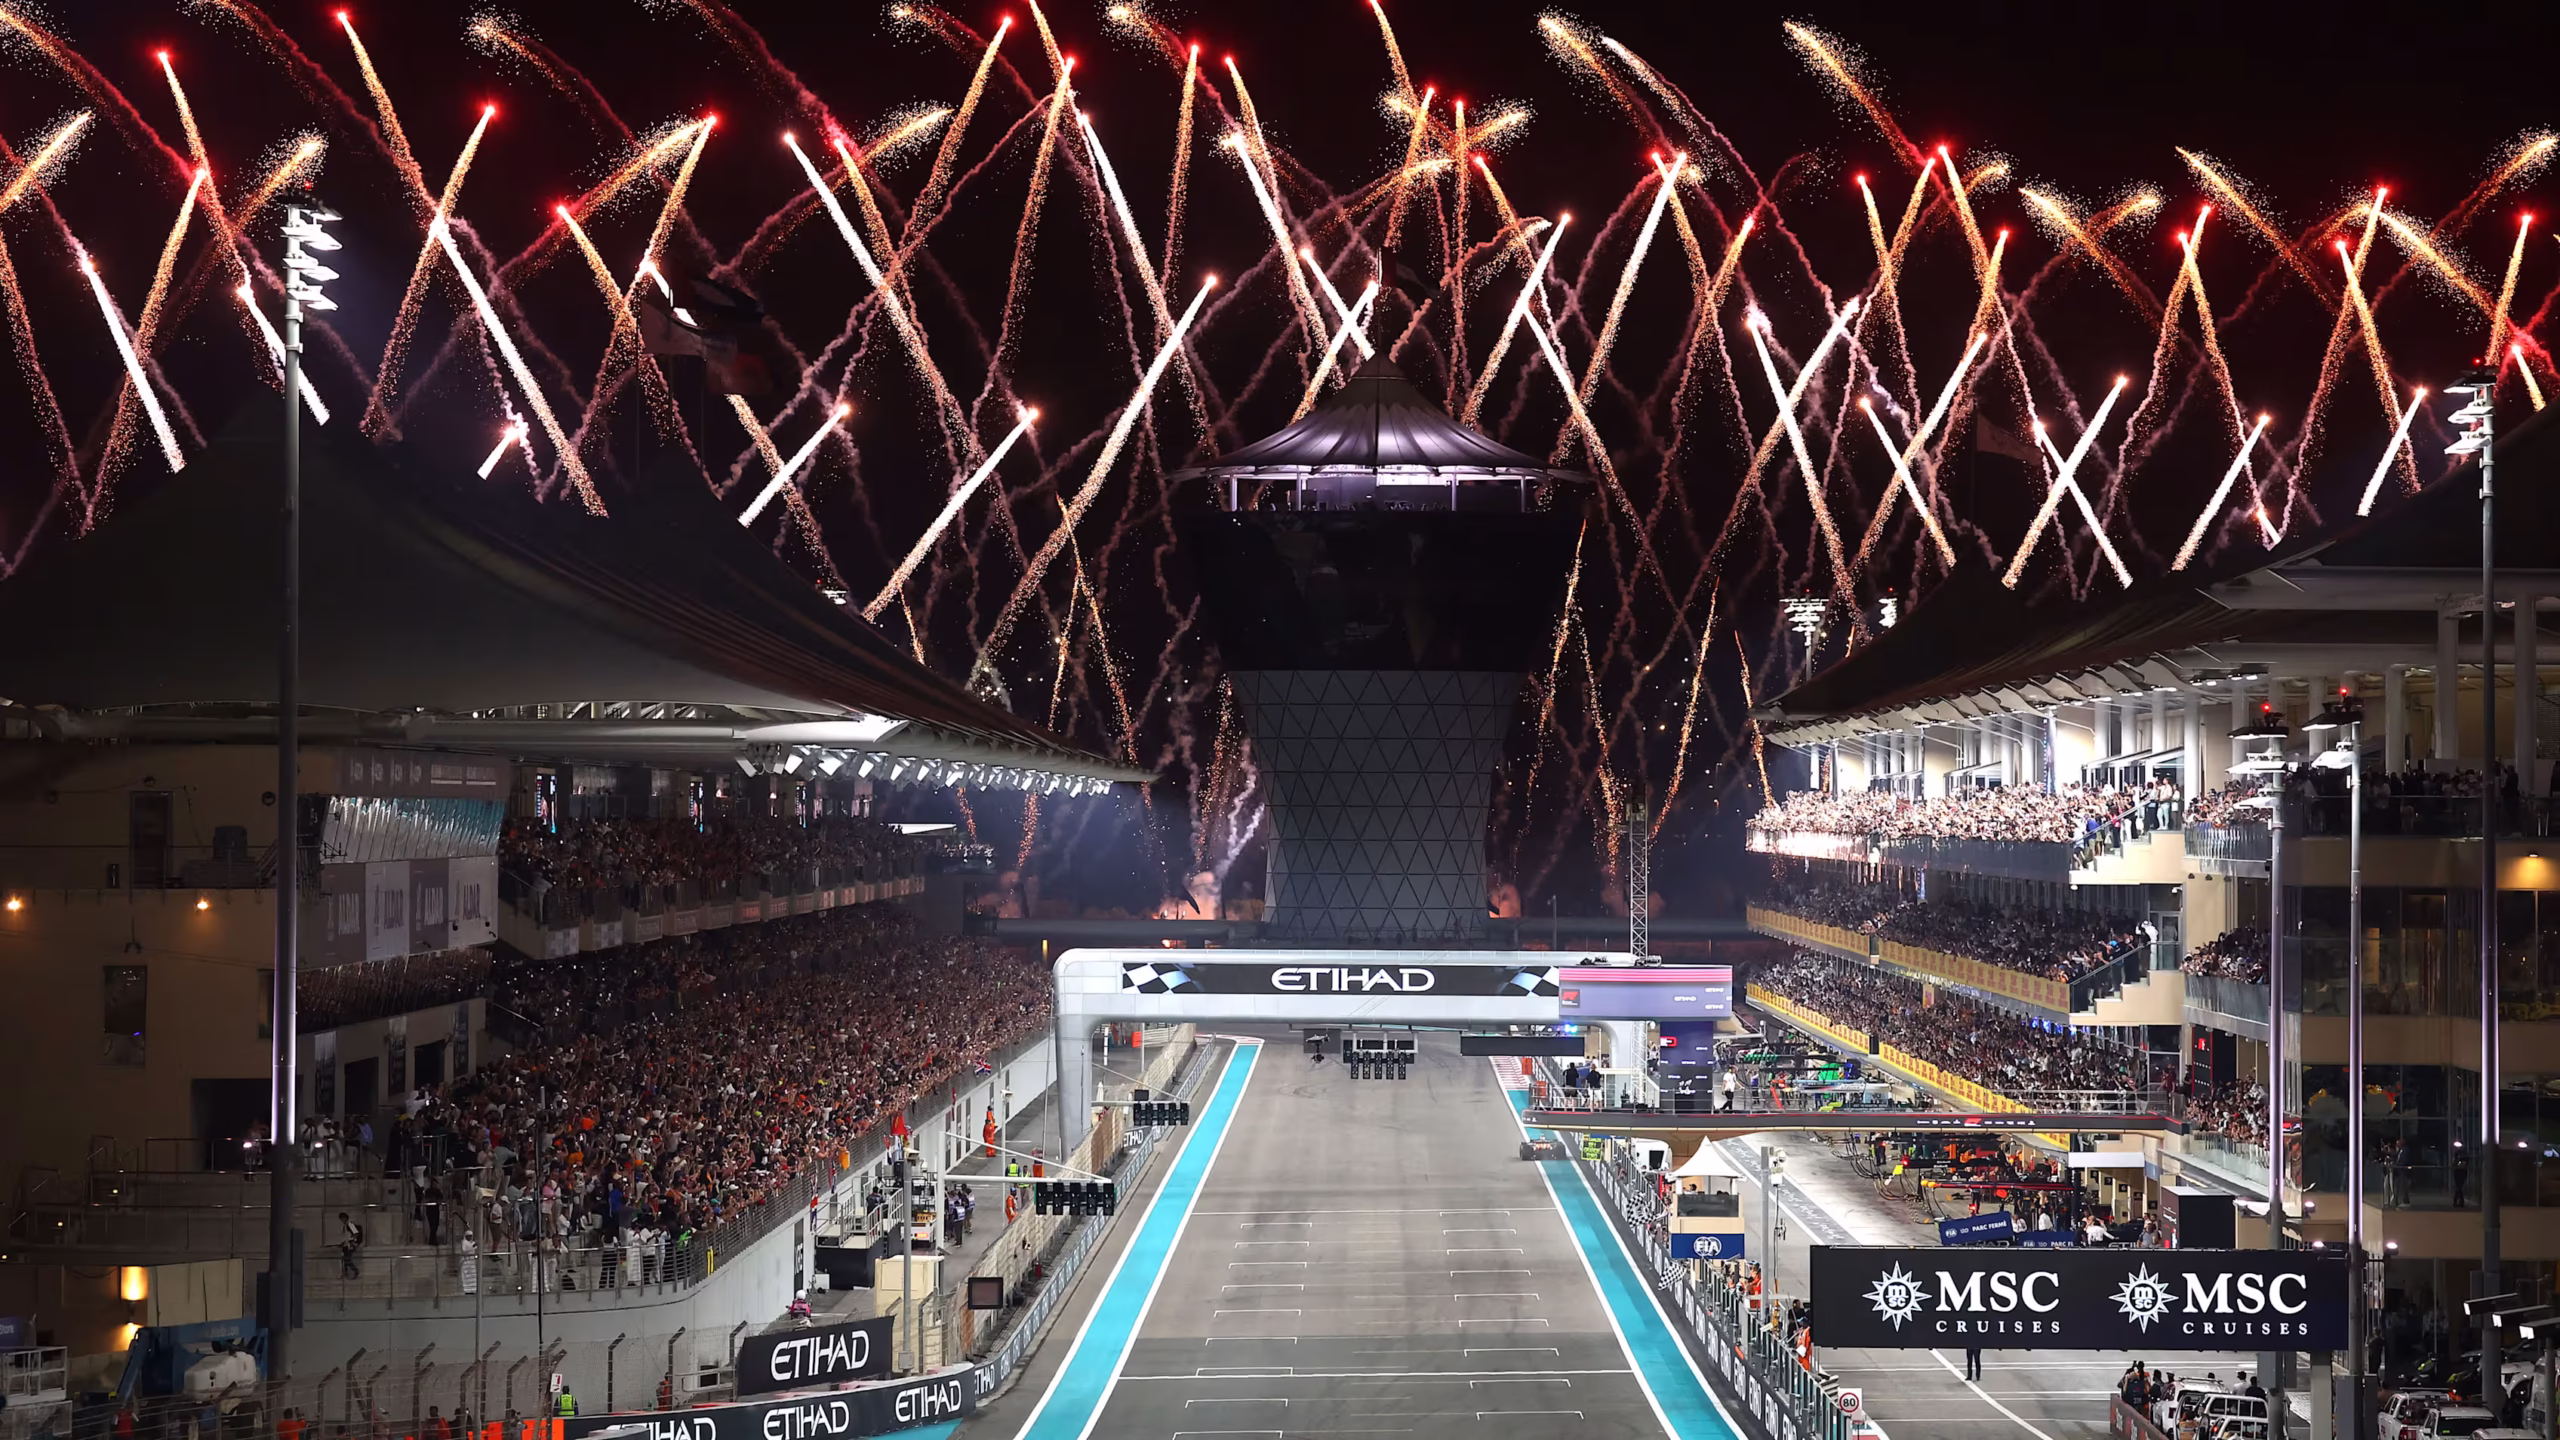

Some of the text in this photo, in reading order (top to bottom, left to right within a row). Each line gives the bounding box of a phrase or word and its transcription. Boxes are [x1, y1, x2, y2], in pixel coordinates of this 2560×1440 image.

[1272, 967, 1435, 992] ETIHAD
[1971, 1224, 1988, 1232] PARC
[1696, 1240, 1718, 1253] FIA
[1934, 1271, 2060, 1313] MSC
[2181, 1272, 2307, 1315] MSC
[1935, 1320, 2061, 1334] CRUISES
[2182, 1321, 2308, 1336] CRUISES
[771, 1330, 869, 1381] ETIHAD
[895, 1380, 962, 1422] ETIHAD
[1843, 1397, 1856, 1407] 80
[606, 1417, 717, 1440] IHAD
[763, 1401, 850, 1440] ETIHAD
